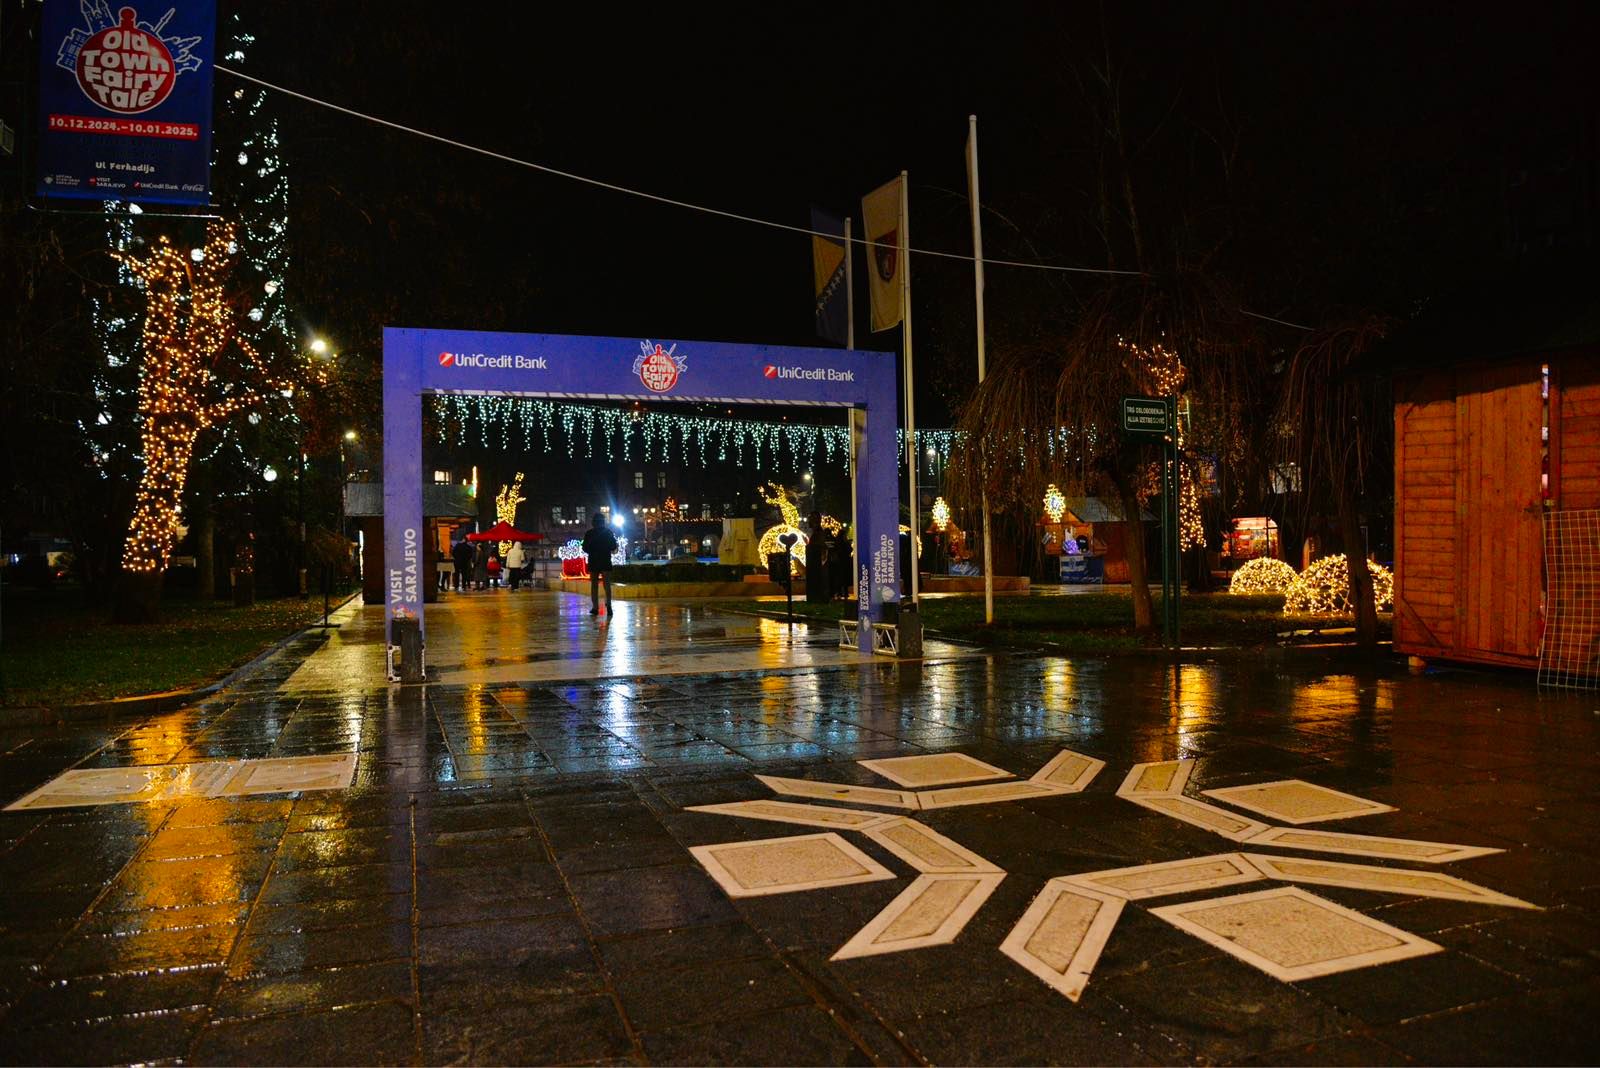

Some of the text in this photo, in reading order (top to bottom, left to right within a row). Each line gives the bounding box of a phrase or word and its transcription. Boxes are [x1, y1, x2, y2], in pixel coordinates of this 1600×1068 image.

[102, 30, 149, 52] Old
[82, 46, 170, 72] Town
[84, 66, 167, 91] Fairy
[91, 83, 156, 108] Tale
[95, 160, 155, 174] Ul Ferhadija
[455, 353, 547, 369] UniCredit Bank
[642, 360, 675, 373] Town
[650, 355, 667, 365] Old
[643, 370, 674, 382] Fairy
[646, 378, 671, 390] Tale
[777, 366, 854, 381] UniCredit Bank
[404, 528, 417, 603] SARAJEVO
[872, 551, 881, 584] OPĆINA
[887, 539, 895, 584] SARAJEVO
[390, 569, 402, 604] VISIT
